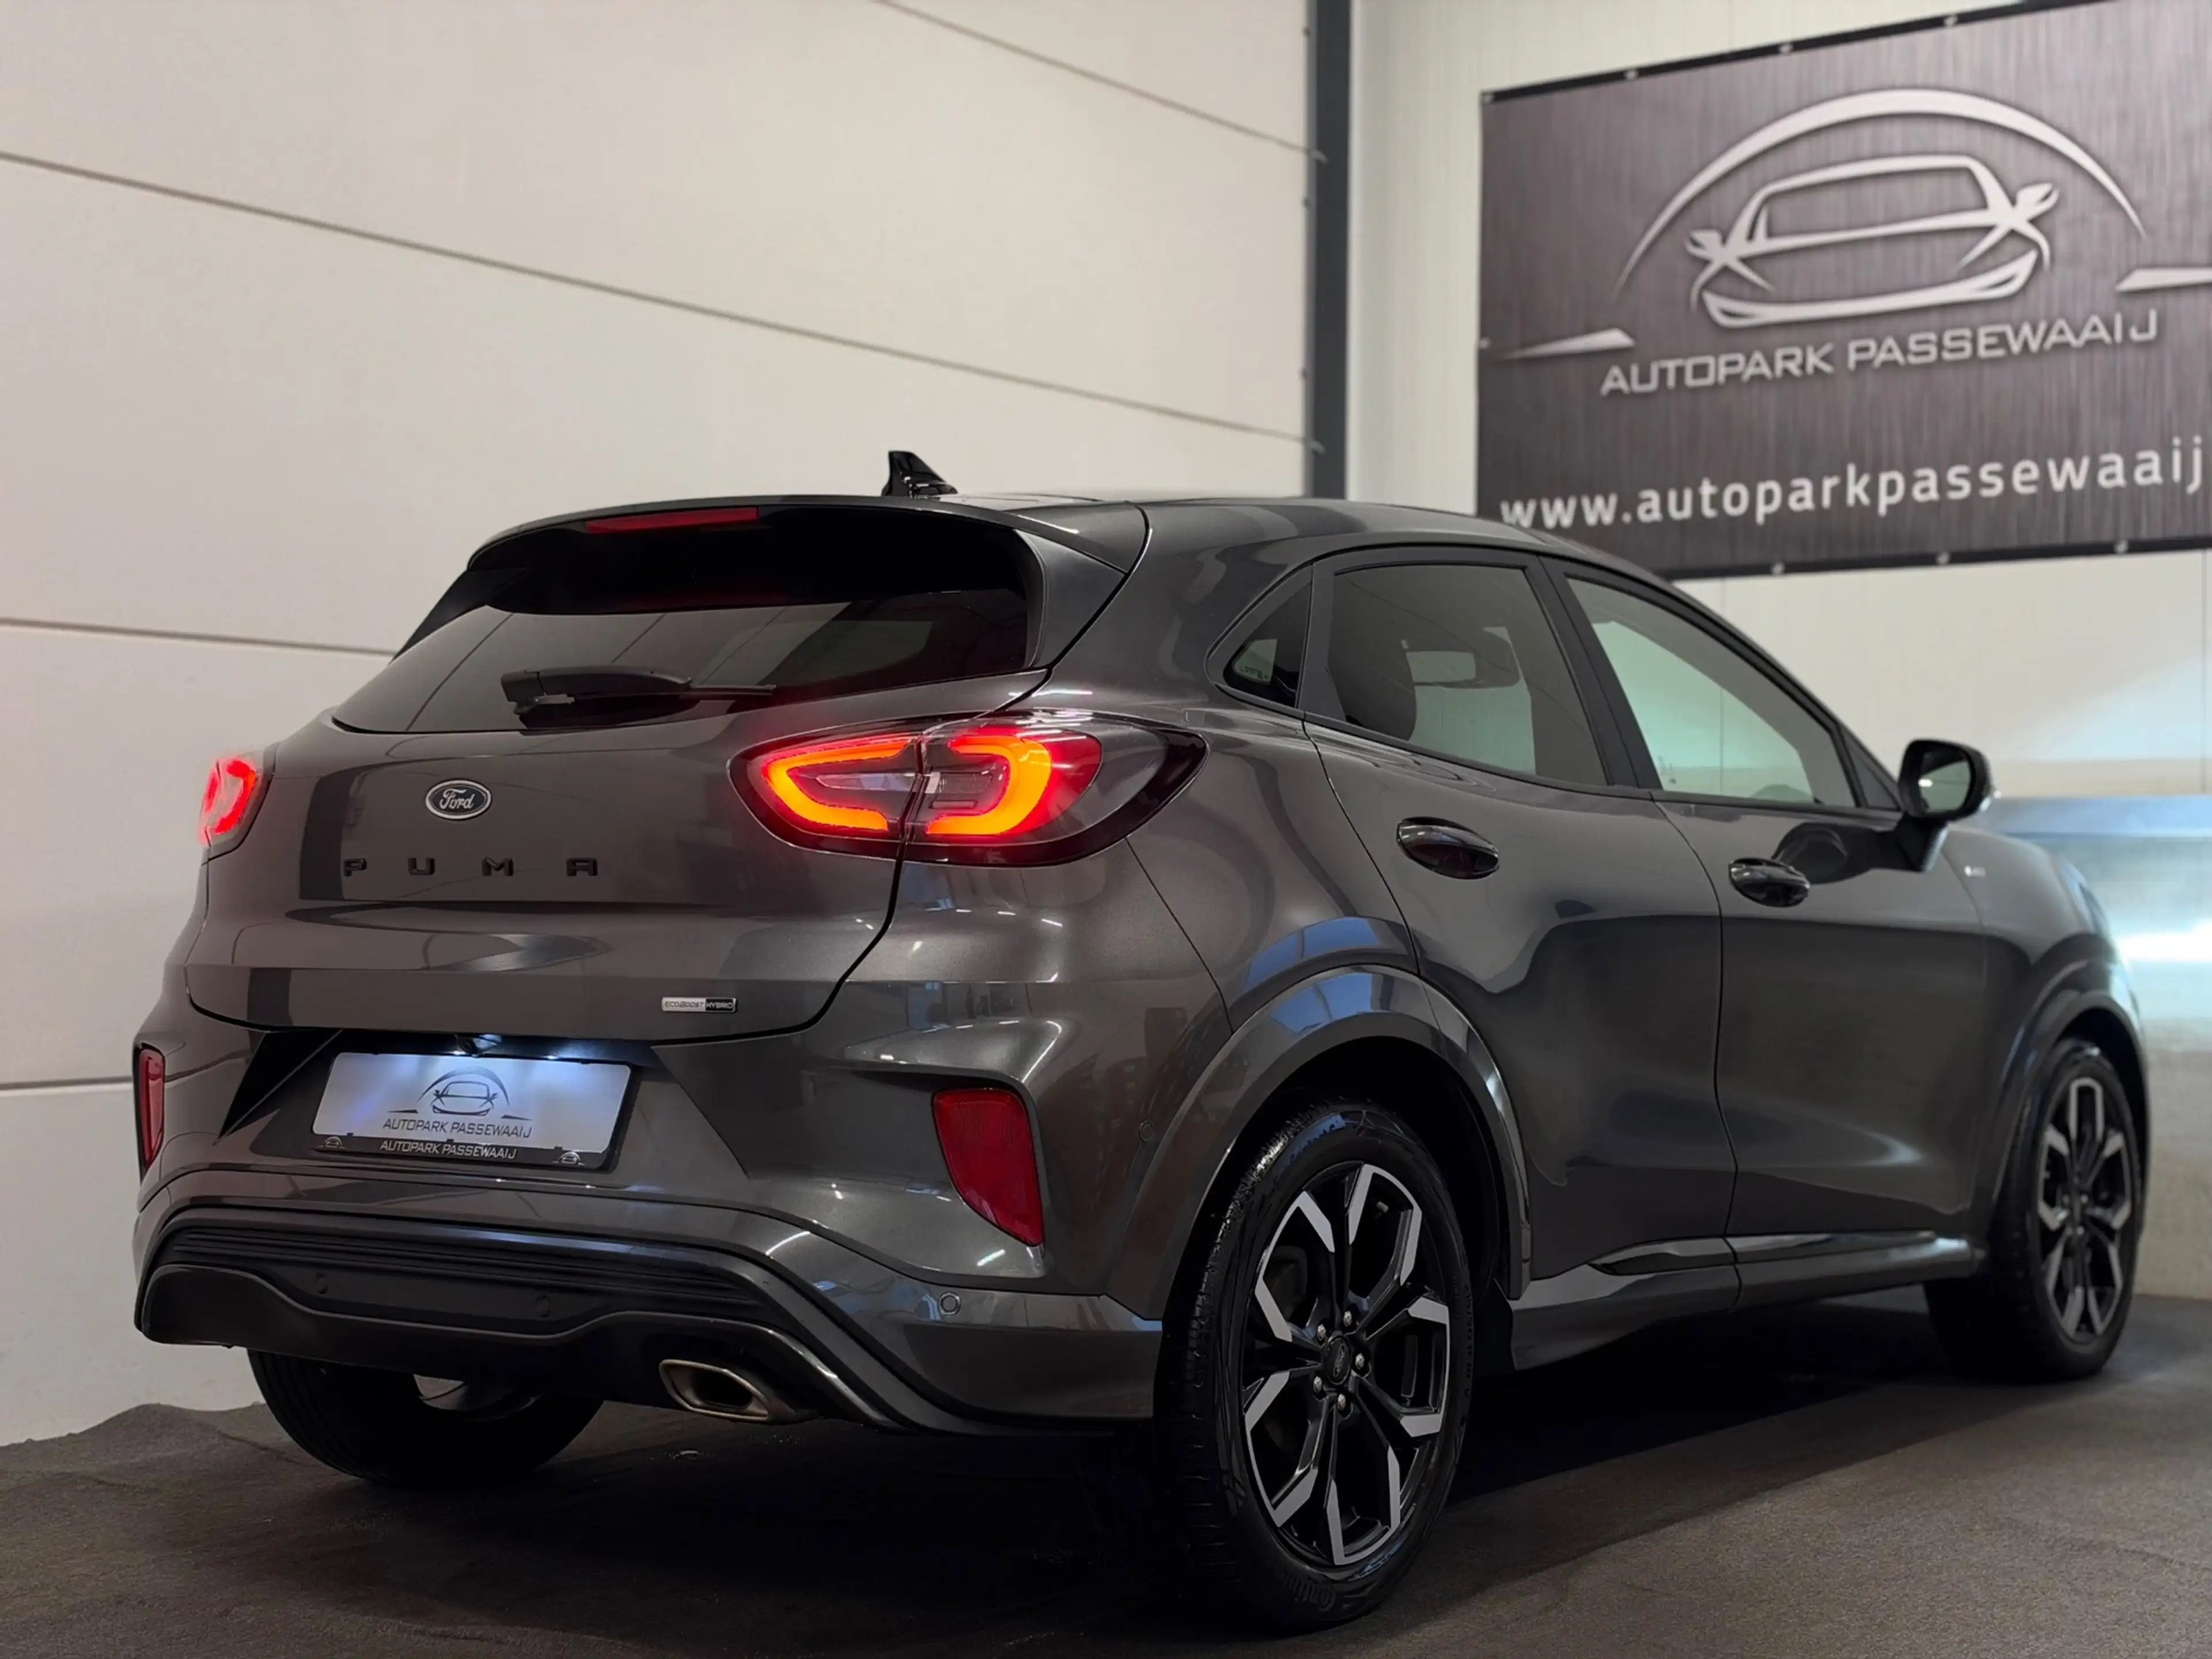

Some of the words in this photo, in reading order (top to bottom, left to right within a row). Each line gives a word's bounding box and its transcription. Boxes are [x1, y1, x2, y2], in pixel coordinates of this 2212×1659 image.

[1600, 342, 1835, 397] AUTOPARK
[1845, 306, 2160, 370] PASSEWAAIJ
[439, 787, 475, 809] Ford
[343, 857, 599, 877] PUMA
[382, 1118, 448, 1133] AUTOPARK
[450, 1122, 532, 1139] PASSEWAAIJ
[380, 1140, 440, 1154] AUTOPARK
[441, 1143, 517, 1160] PASSEWAAIJ
